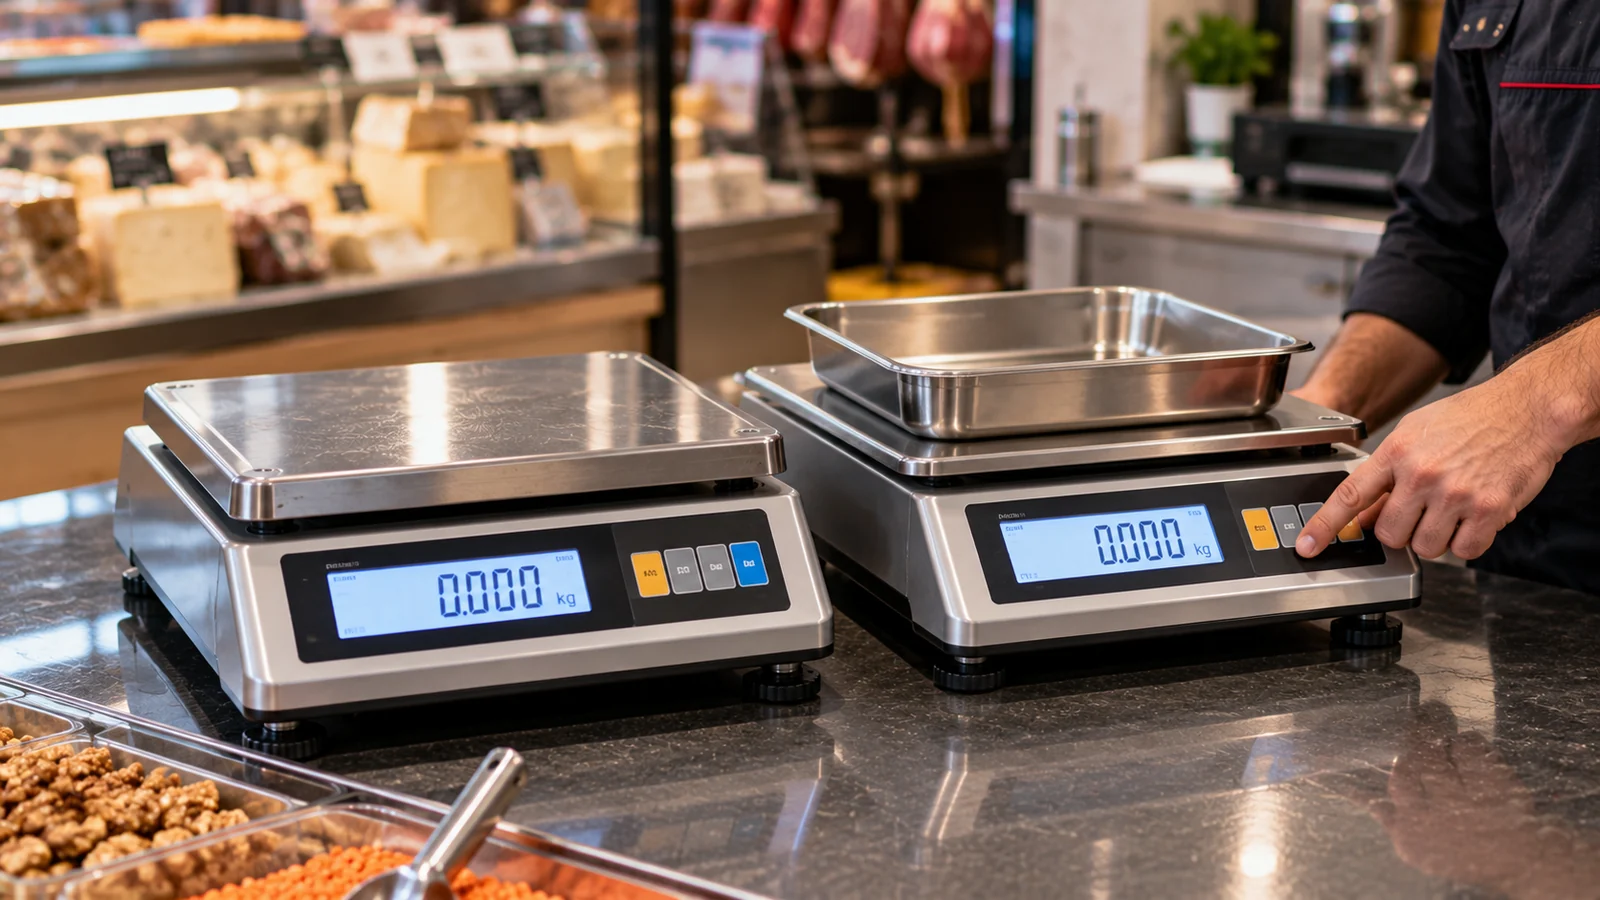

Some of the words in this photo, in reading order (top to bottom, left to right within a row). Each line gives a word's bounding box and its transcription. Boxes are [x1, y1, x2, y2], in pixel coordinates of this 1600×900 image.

[1094, 518, 1186, 565] 0.000
[1194, 543, 1211, 558] kg
[438, 565, 543, 618] 0.000
[556, 592, 576, 607] kg
